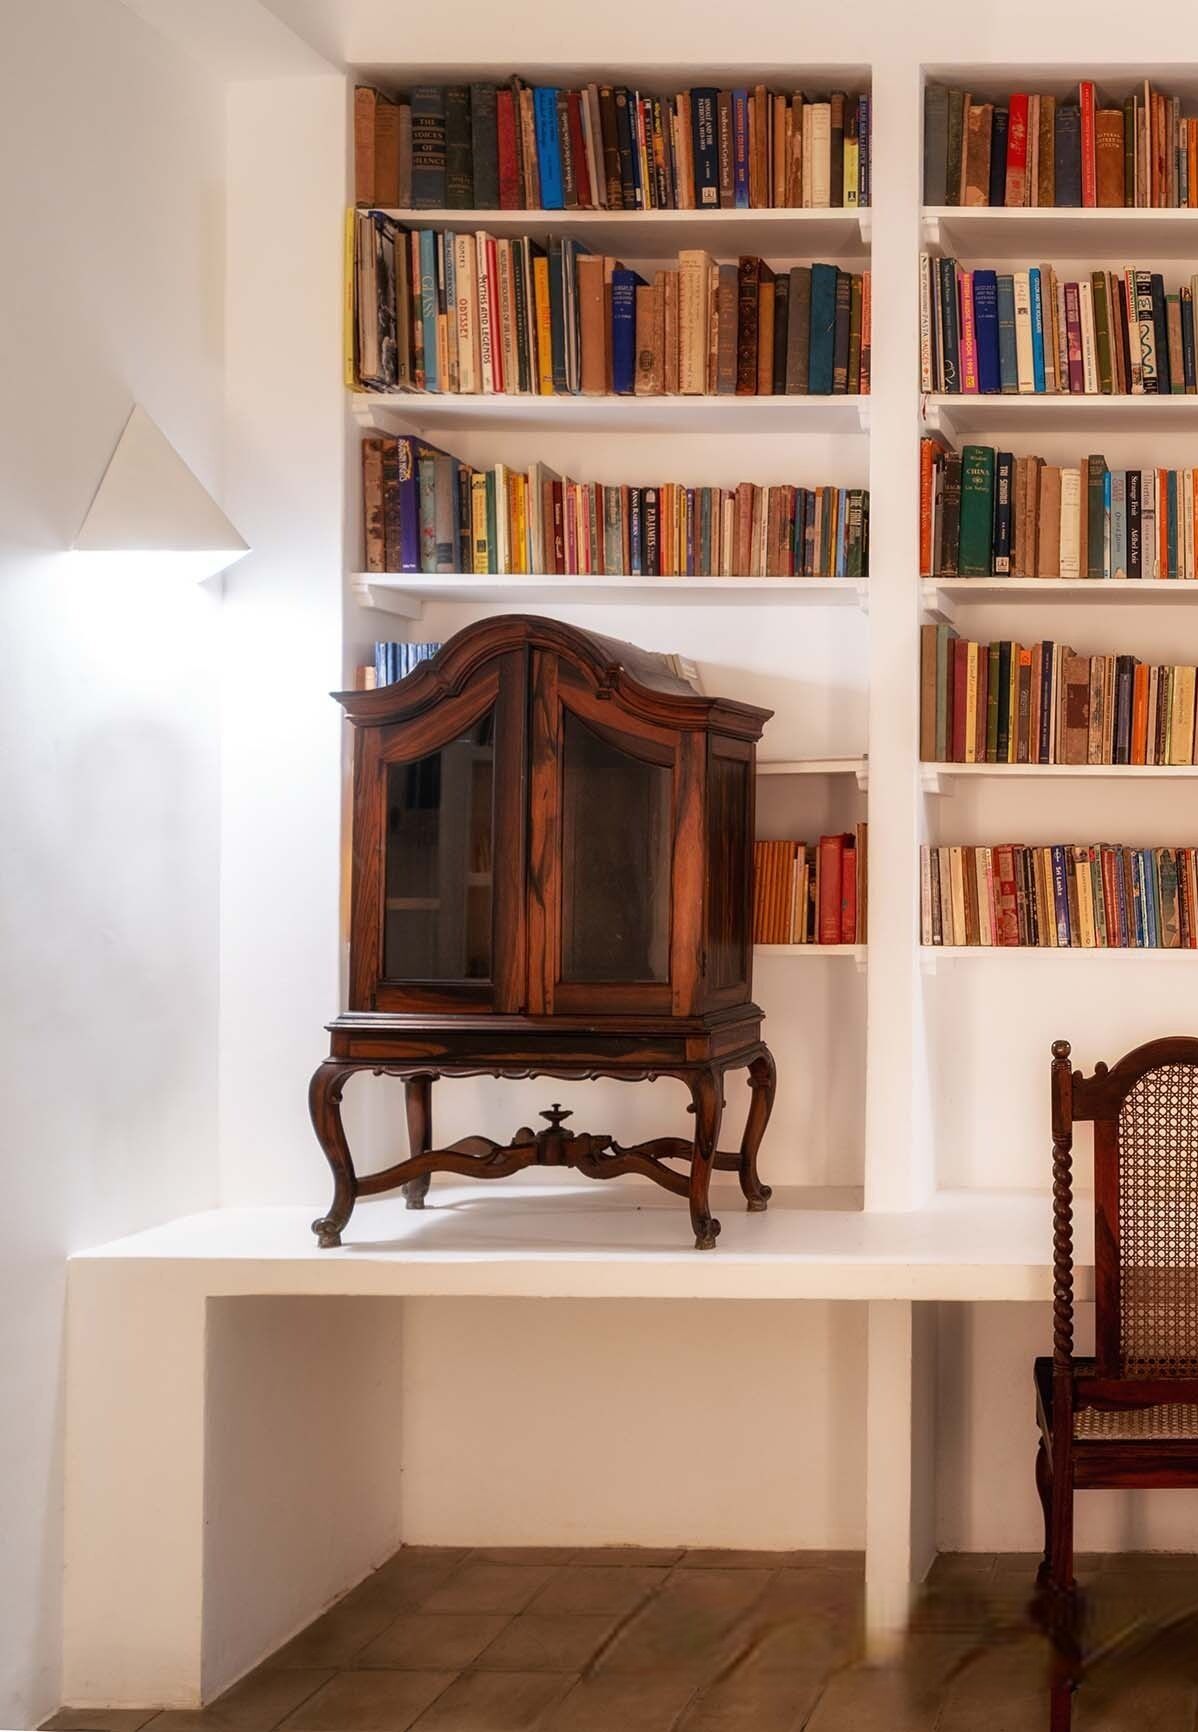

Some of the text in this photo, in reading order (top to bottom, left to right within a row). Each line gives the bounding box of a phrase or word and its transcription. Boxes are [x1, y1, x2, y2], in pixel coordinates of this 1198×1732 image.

[419, 118, 436, 126] THE
[422, 274, 434, 319] GLASS
[501, 277, 509, 312] RESOURCES
[459, 298, 468, 339] ODYSSEY
[479, 278, 491, 364] MYTHS AND LEGENDS
[503, 314, 509, 324] OF
[965, 321, 973, 356] YEARBOOK
[851, 496, 862, 507] THE
[1000, 466, 1008, 504] TRI SINHALA
[1130, 476, 1139, 515] Strange Fruit
[1143, 475, 1152, 506] Ulverton
[850, 509, 861, 525] FIRM
